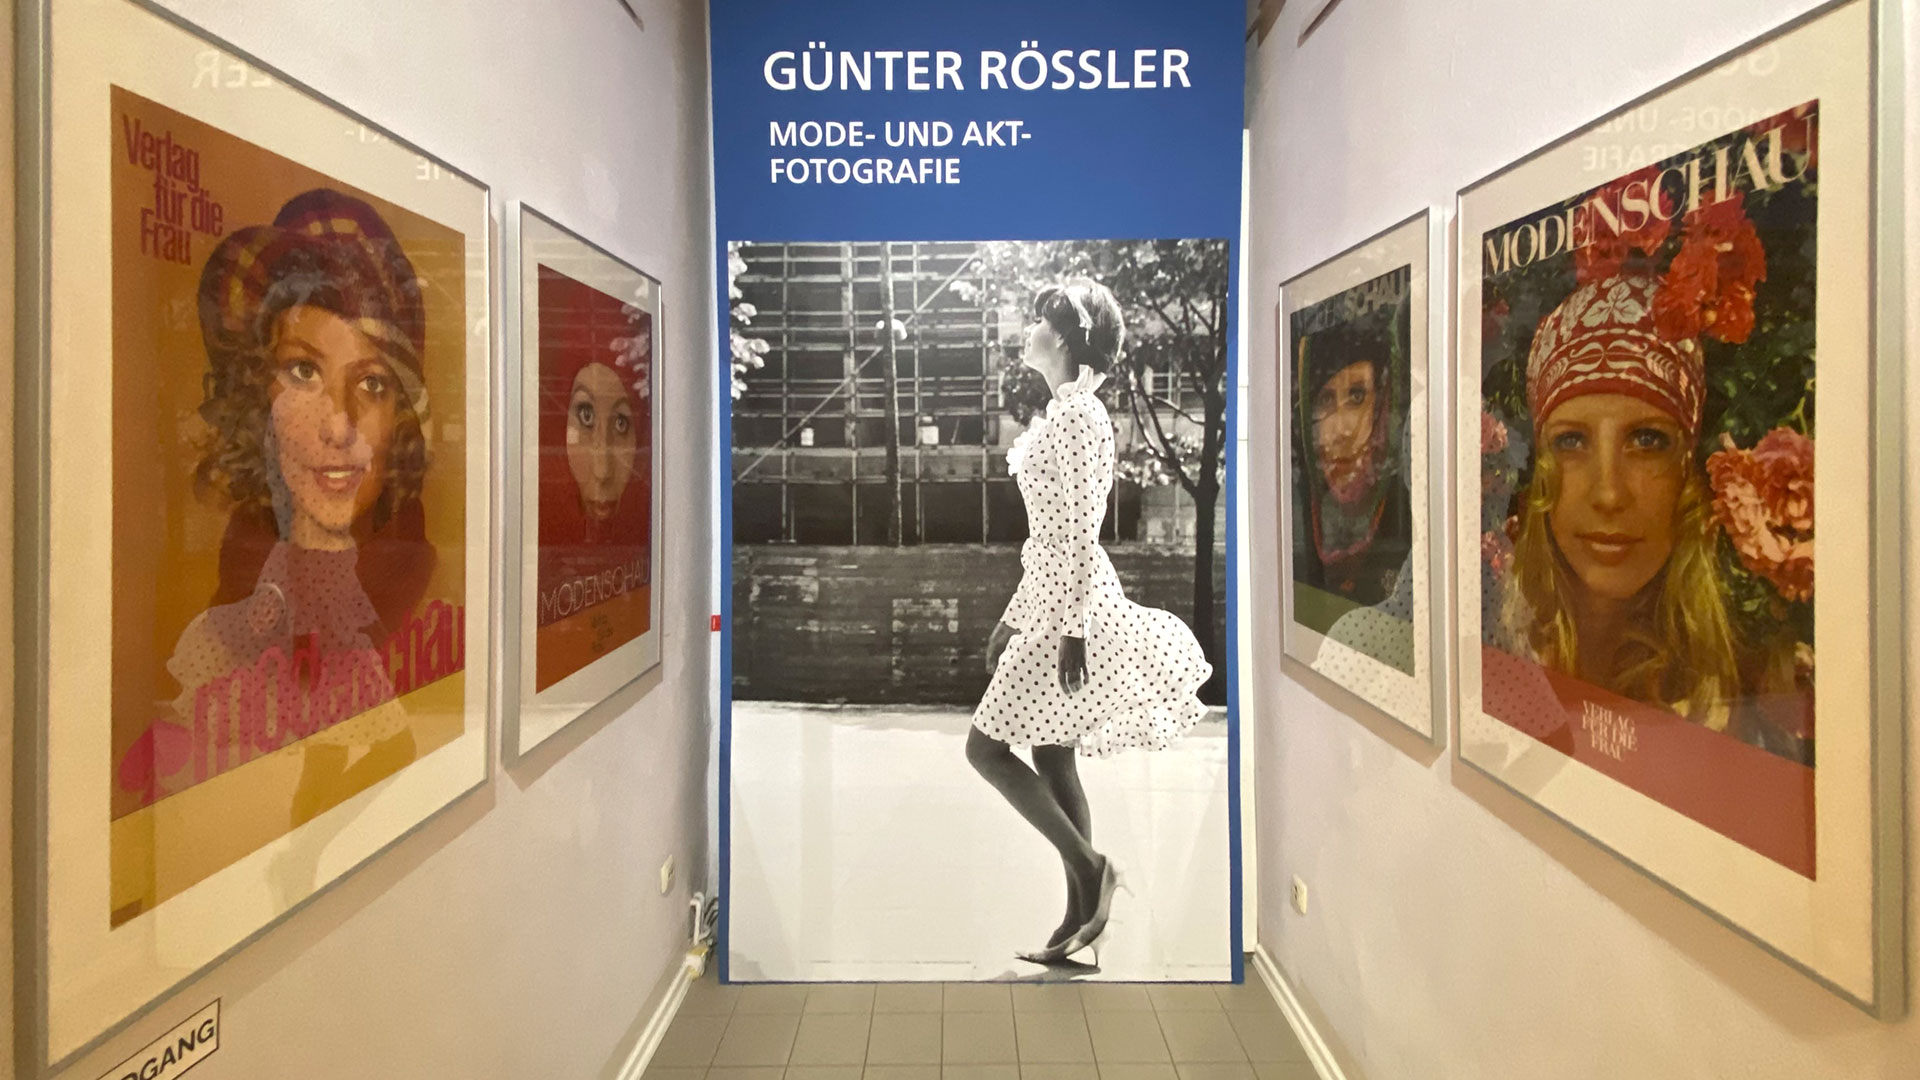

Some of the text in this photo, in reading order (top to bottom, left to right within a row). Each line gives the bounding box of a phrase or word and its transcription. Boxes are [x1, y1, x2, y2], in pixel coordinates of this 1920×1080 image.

[763, 41, 1191, 91] GÜNTER RÖSSLER
[122, 114, 200, 193] Verlag
[769, 120, 1031, 147] MODE- UND AKT-
[770, 158, 961, 184] FOTOGRAFIE
[1485, 114, 1817, 277] MODENSCHAU
[140, 207, 192, 265] Frau
[153, 176, 224, 237] für die
[541, 558, 650, 625] MODENSCHAU
[193, 599, 466, 785] modenschau
